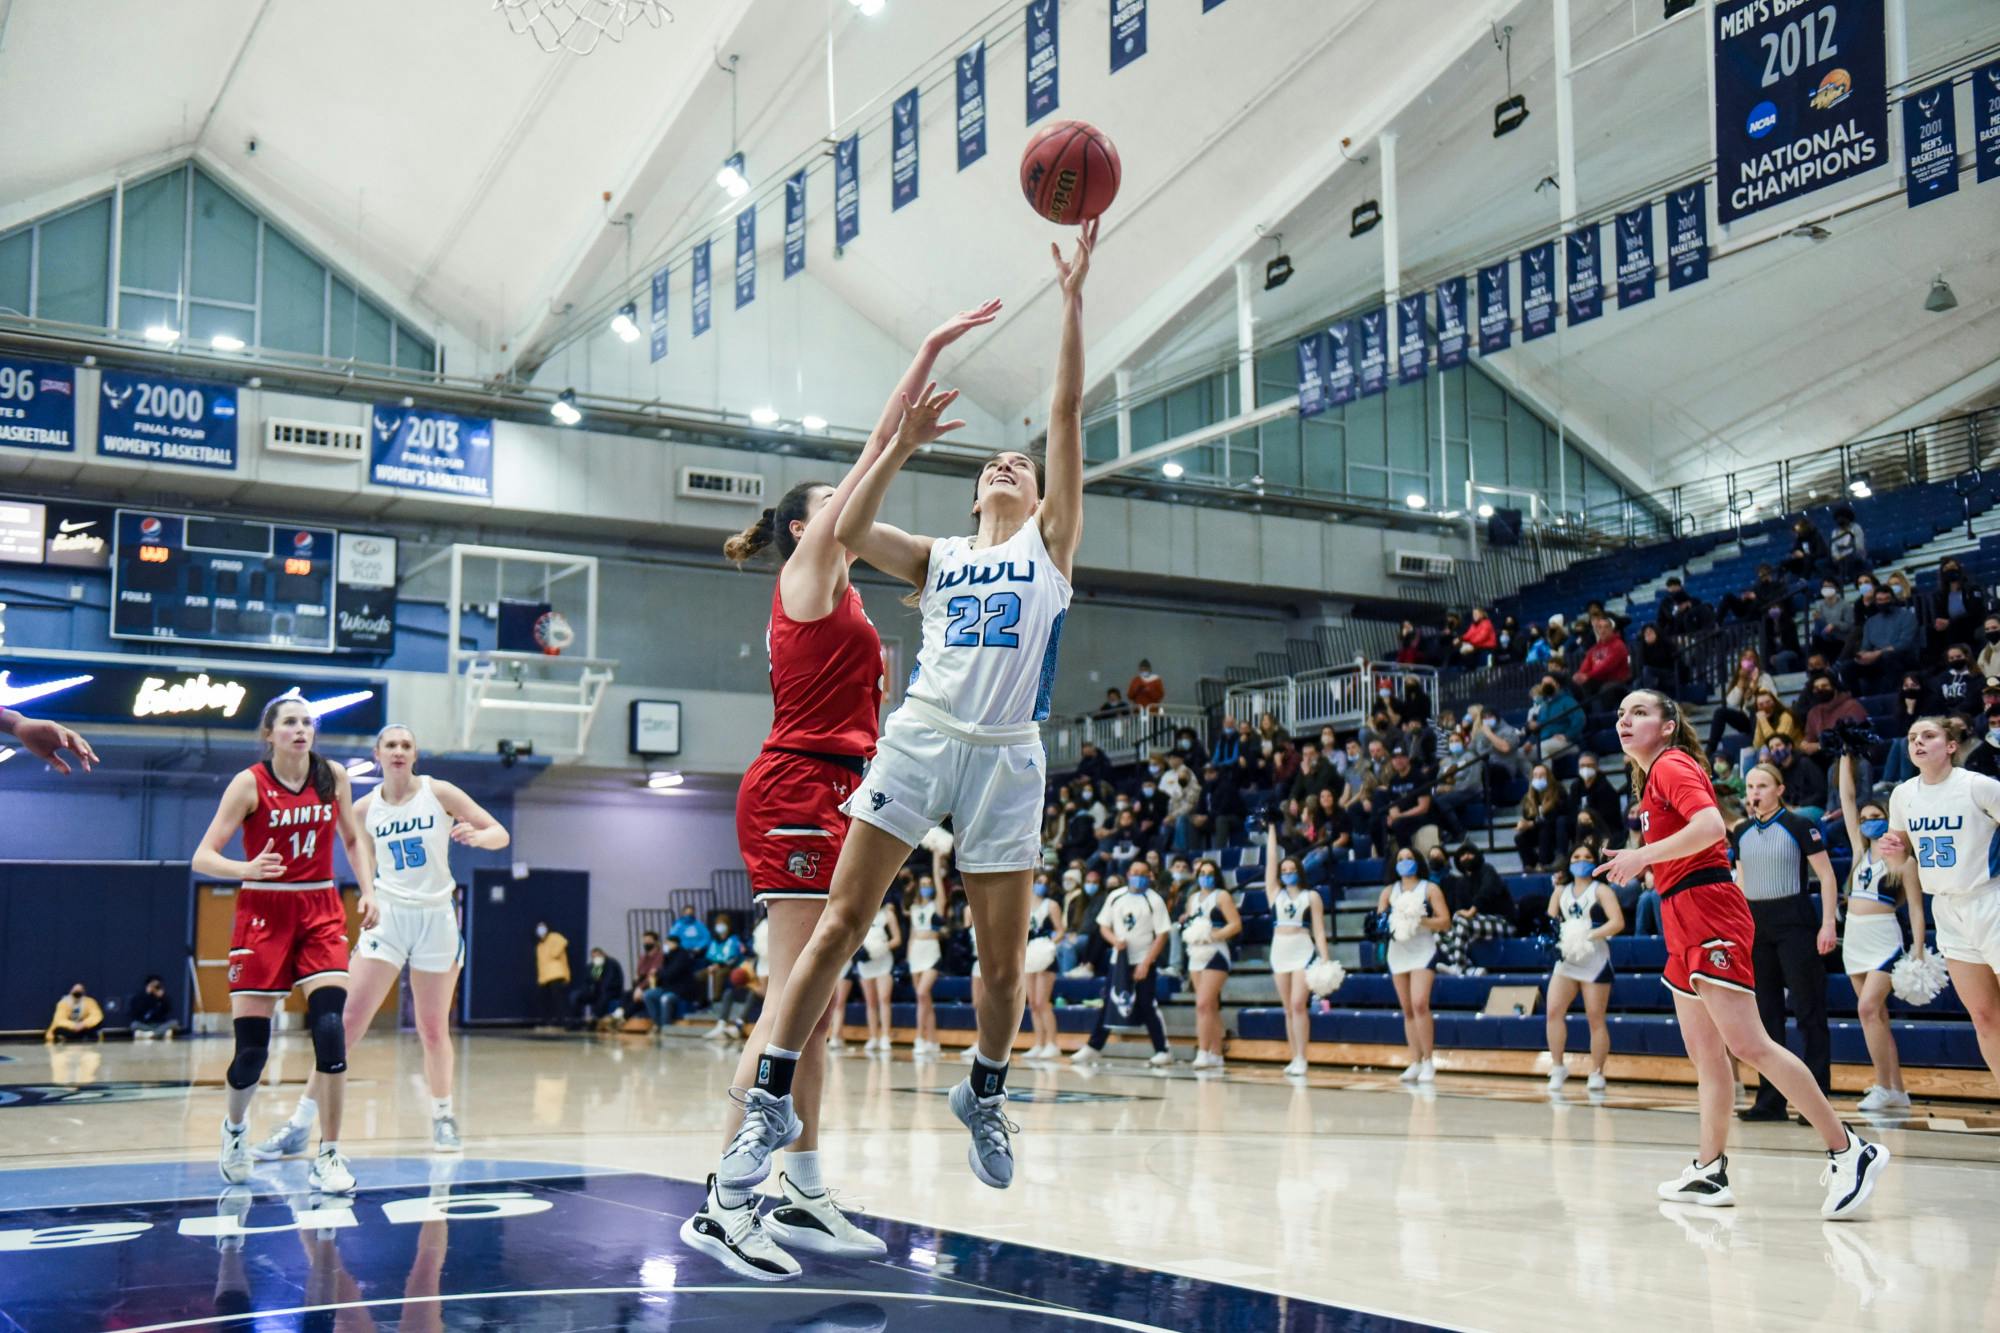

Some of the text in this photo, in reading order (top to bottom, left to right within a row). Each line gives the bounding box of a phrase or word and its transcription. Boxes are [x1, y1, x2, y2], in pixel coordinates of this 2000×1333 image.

[1720, 0, 1769, 40] MEN'S
[1761, 5, 1838, 88] 2012
[1749, 114, 1776, 134] NCAA
[1920, 119, 1942, 139] 2001
[1741, 118, 1865, 183] NATIONAL
[1911, 144, 1953, 167] BASKETBALL
[1921, 136, 1943, 152] MEN'S
[1731, 138, 1876, 210] CHAMPIONS
[1678, 214, 1697, 232] 2001
[1670, 236, 1704, 256] BASKETBALL
[1679, 229, 1697, 243] MEN'S
[0, 367, 35, 401] 96
[15, 408, 26, 419] 8
[135, 383, 204, 422] 2000
[133, 422, 205, 440] FINAL FOUR
[406, 416, 459, 452] 2013
[103, 435, 233, 465] WOMEN'S BASKETBALL
[401, 451, 464, 470] FINAL FOUR
[375, 464, 488, 495] WOMEN'S BASKETBALL
[211, 559, 243, 572] PERIOD
[936, 560, 1035, 592] WWU
[121, 591, 152, 603] FOULS
[339, 611, 392, 635] Woods
[945, 592, 1022, 649] 22
[268, 804, 332, 828] SAINTS
[376, 816, 434, 838] WWU
[1908, 816, 1963, 832] WWU
[289, 830, 317, 859] 14
[388, 837, 426, 870] 15
[1919, 836, 1957, 868] 25
